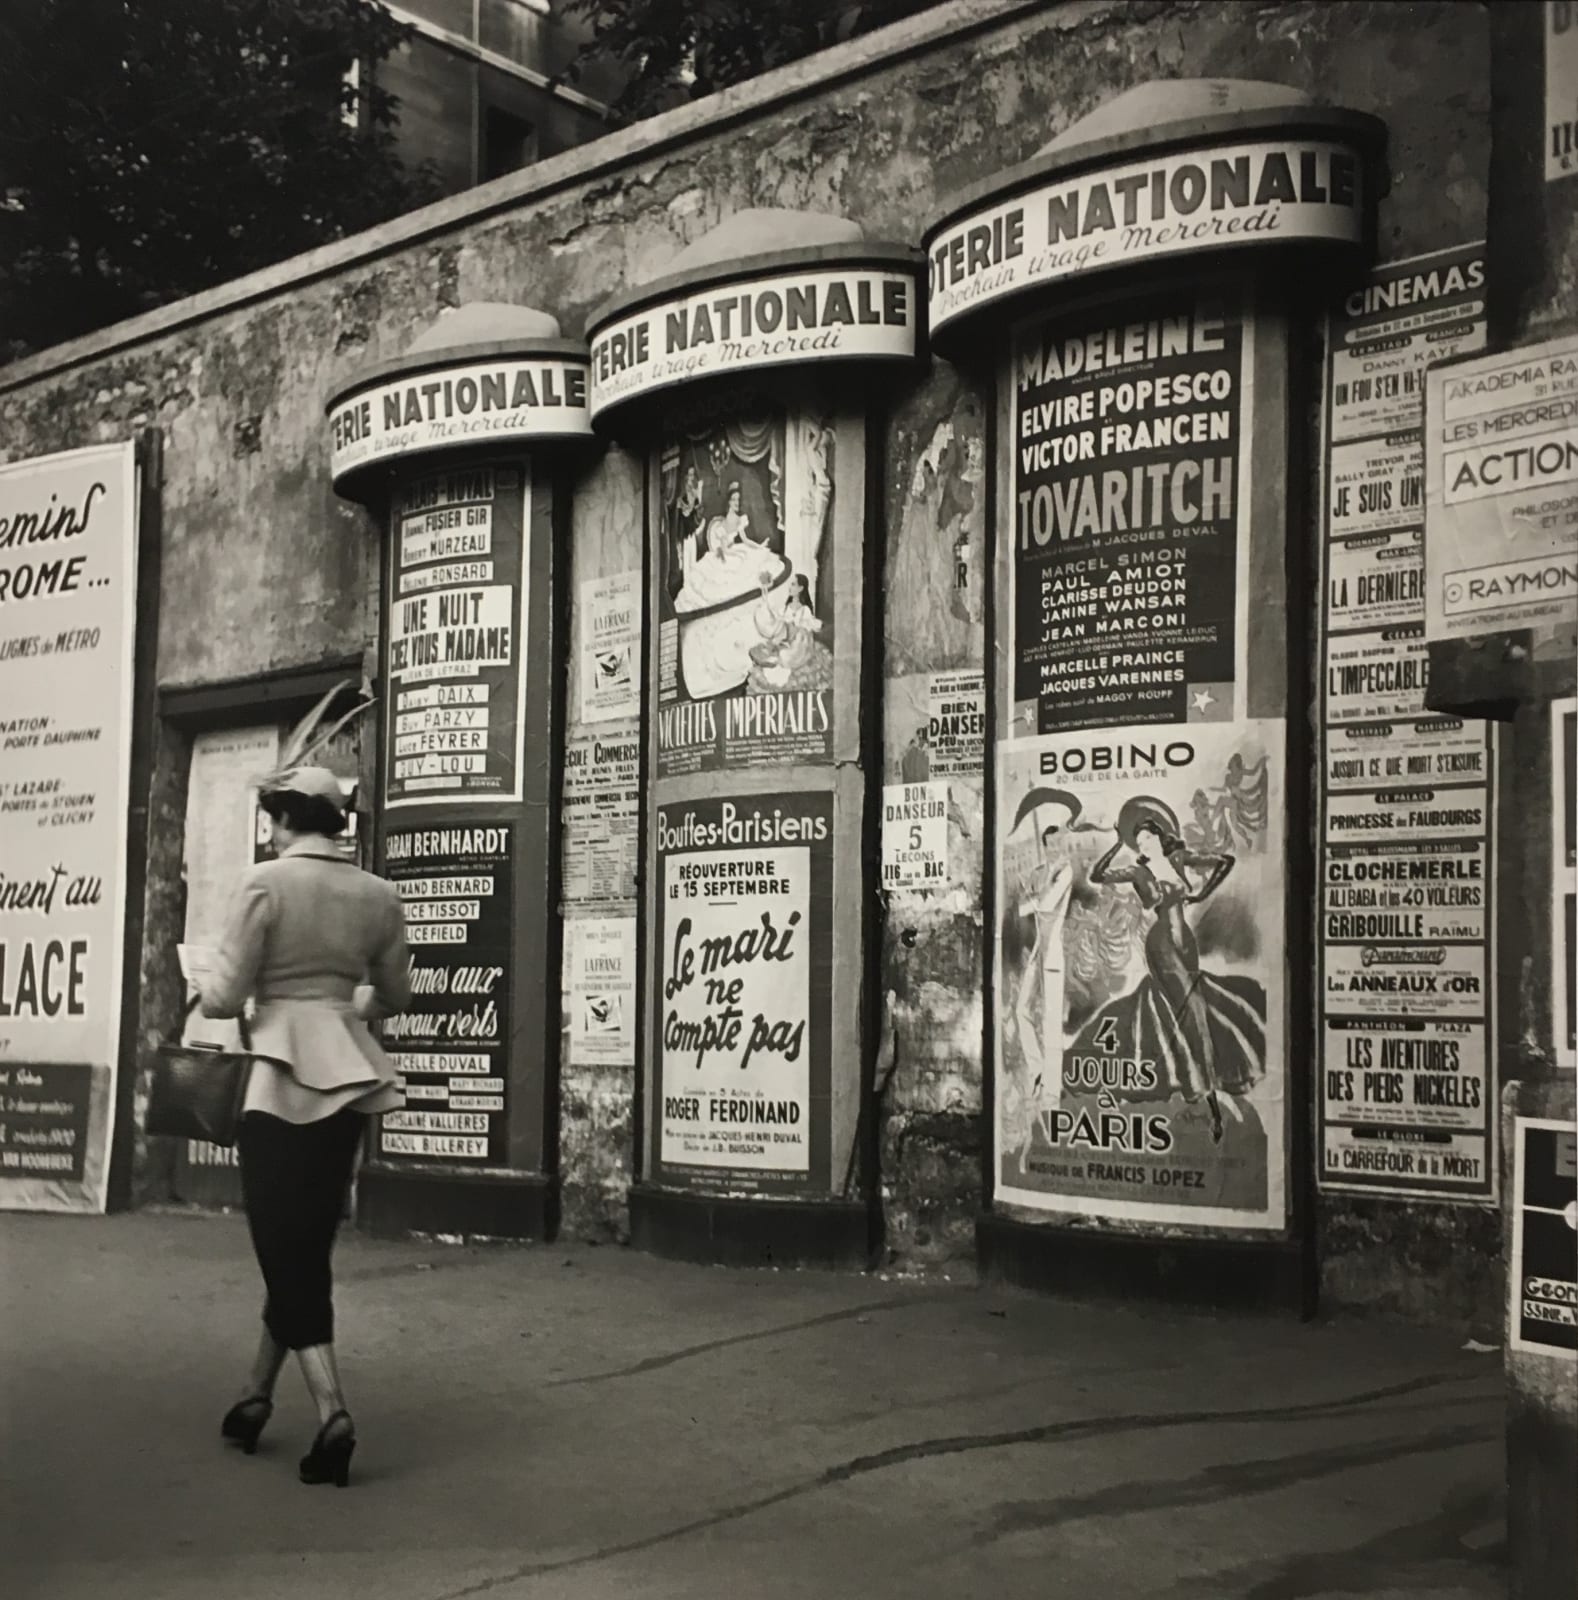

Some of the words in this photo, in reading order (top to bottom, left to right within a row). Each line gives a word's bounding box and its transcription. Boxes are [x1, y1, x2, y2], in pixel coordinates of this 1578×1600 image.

[1047, 148, 1357, 246] NATIONALE
[1120, 205, 1282, 252] Mercredi
[1345, 260, 1485, 316] CINEMAS
[666, 281, 907, 354] NATIONALE
[719, 329, 842, 363] Mercredi
[1018, 303, 1225, 392] MADELEINE
[1362, 357, 1405, 373] DANNY
[1414, 344, 1460, 363] KAYE
[1352, 376, 1372, 403] FOU
[1449, 365, 1545, 400] AKADEMIA
[383, 369, 586, 431] NATIONALE
[1021, 391, 1094, 438] ELVIRE
[1100, 369, 1232, 417] POPESCO
[428, 411, 528, 440] Mercredi
[1443, 421, 1478, 444] LES
[1021, 431, 1095, 475] VICTOR
[1101, 411, 1230, 456] FRANCEN
[1335, 471, 1365, 484] SALLY
[1368, 467, 1395, 480] GRAY
[1366, 455, 1404, 468] TREVOR
[1452, 440, 1578, 492] ACTION
[1018, 456, 1233, 550] TOVARITCH
[1333, 486, 1350, 517] JE
[1359, 480, 1393, 514] SUIS
[425, 510, 461, 532] FUSIER
[467, 507, 487, 527] GIR
[430, 534, 486, 557] MURZEAU
[1105, 531, 1165, 546] JACQUES
[1172, 525, 1219, 538] DEVAL
[432, 562, 487, 584] RONSARD
[1041, 558, 1109, 580] MARCEL
[1117, 548, 1187, 566] SIMON
[1041, 576, 1091, 594] PAUL
[1106, 562, 1187, 584] AMIOT
[1041, 587, 1107, 609] CLARISSE
[1112, 578, 1187, 597] DEUDON
[1331, 578, 1348, 608] LA
[403, 598, 427, 634] UNE
[438, 592, 484, 628] NUIT
[1041, 603, 1097, 624] JANINE
[1105, 594, 1187, 613] WANSAR
[1041, 623, 1085, 643] JEAN
[1096, 612, 1187, 634] MARCONI
[412, 631, 439, 668] VOUS
[446, 624, 509, 662] MADAME
[1040, 656, 1107, 678] MARCELLE
[1112, 650, 1185, 668] PRAINCE
[1329, 657, 1428, 696] L'IMPECCABLE
[437, 686, 476, 705] DAIX
[1040, 676, 1096, 696] JACQUES
[1098, 668, 1186, 688] VARENNES
[424, 709, 476, 728] PARZY
[725, 690, 829, 740] IMPERIALES
[941, 701, 978, 715] BIEN
[4, 735, 40, 750] PORTE
[43, 726, 102, 748] DAUPHINE
[420, 731, 481, 750] FEYRER
[938, 736, 956, 747] PEU
[1040, 741, 1195, 775] BOBINO
[1370, 758, 1381, 776] CE
[1408, 754, 1432, 774] MORT
[13, 777, 61, 797] LAZARE
[1072, 771, 1094, 783] RUE
[1098, 770, 1112, 781] DE
[1115, 769, 1129, 780] LA
[904, 785, 928, 803] BON
[51, 810, 96, 826] CLICHY
[886, 800, 945, 823] DANSEUR
[1330, 812, 1394, 831] PRINCESSE
[1409, 808, 1483, 828] FAUBOURGS
[386, 833, 412, 860] SARAH
[414, 828, 509, 857] BERNHARDT
[908, 824, 923, 851] 5
[679, 860, 775, 881] RÉOUVERTURE
[884, 864, 901, 881] 116
[925, 861, 944, 878] BAC
[1328, 859, 1481, 882] CLOCHEMERLE
[65, 876, 103, 906] au
[431, 878, 491, 893] BERNARD
[669, 885, 679, 899] LE
[683, 881, 698, 898] 15
[703, 878, 790, 897] SEPTEMBRE
[1328, 889, 1346, 907] ALI
[1350, 888, 1377, 907] BABA
[1402, 887, 1425, 906] 40
[1427, 886, 1481, 907] VOLEURS
[428, 902, 478, 917] TISSOT
[430, 925, 465, 940] FIELD
[1328, 913, 1424, 938] GRIBOUILLE
[1429, 925, 1480, 937] RAIMU
[664, 917, 695, 1001] Le
[699, 910, 802, 976] mari
[450, 966, 503, 994] aux
[704, 977, 744, 1006] ne
[1348, 976, 1438, 993] ANNEAUX
[447, 1000, 498, 1038] verts
[1436, 1023, 1472, 1033] PLAZA
[740, 1013, 806, 1070] pas
[1093, 1016, 1120, 1054] 4
[439, 1055, 487, 1071] DUVAL
[1347, 1037, 1373, 1069] LES
[1380, 1037, 1460, 1072] AVENTURES
[1063, 1056, 1158, 1091] JOURS
[1097, 1086, 1119, 1112] à
[1327, 1070, 1354, 1101] DES
[1364, 1071, 1404, 1104] PIEDS
[1413, 1073, 1481, 1108] NICKELES
[665, 1097, 700, 1121] ROGER
[709, 1099, 801, 1125] FERDINAND
[773, 1132, 802, 1144] DUVAL
[1047, 1107, 1174, 1155] PARIS
[422, 1137, 484, 1154] BILLEREY
[1087, 1162, 1146, 1185] FRANCIS
[1151, 1168, 1206, 1189] LOPEZ
[1343, 1149, 1414, 1173] CARREFOUR
[1443, 1155, 1480, 1179] MORT
